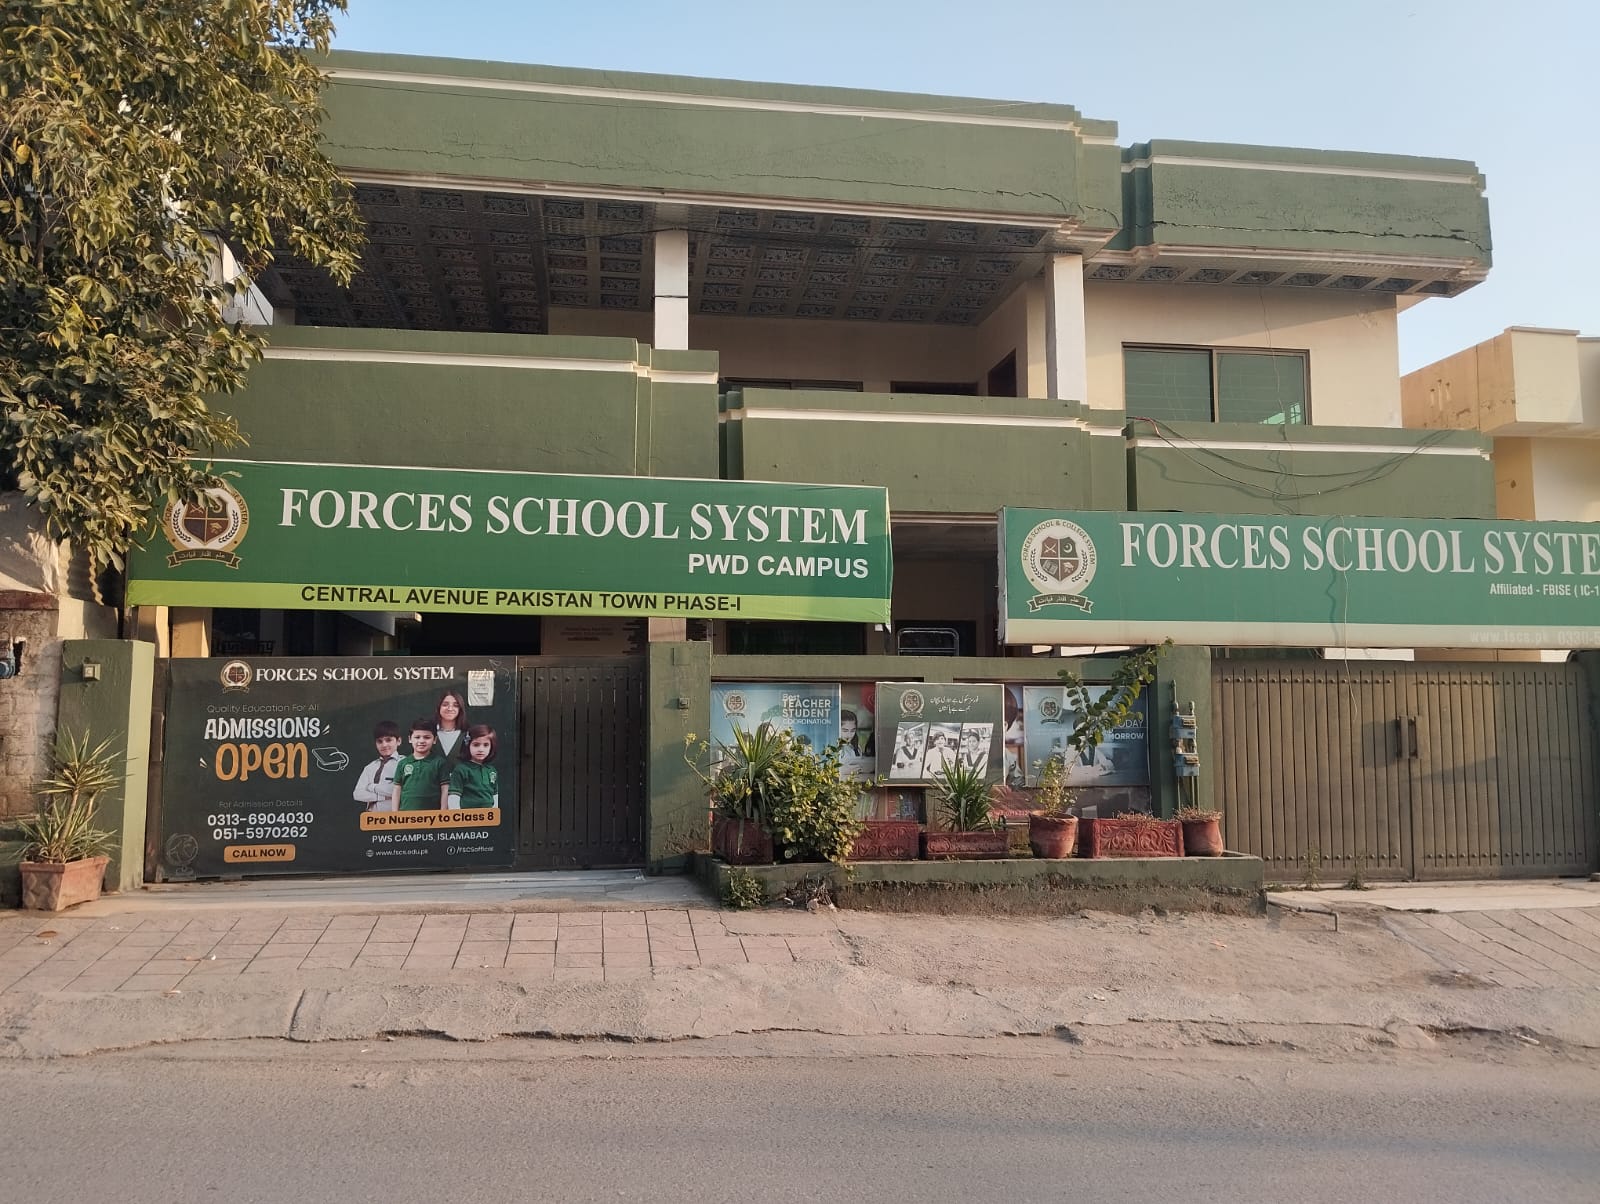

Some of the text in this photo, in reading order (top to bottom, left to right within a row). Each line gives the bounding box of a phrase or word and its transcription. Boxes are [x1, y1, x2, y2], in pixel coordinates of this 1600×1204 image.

[278, 488, 472, 533] FORCES
[486, 495, 679, 540] SCHOOL
[690, 502, 868, 545] SYSTEM
[1023, 536, 1033, 561] FORCES
[1031, 521, 1054, 538] SCHOOL
[1062, 521, 1087, 540] COLLEGE
[1085, 538, 1096, 565] SYSTEM
[1120, 522, 1600, 576] FORCES SCHOOL SYSTE
[688, 553, 869, 579] PWD CAMPUS
[1489, 583, 1533, 595] Affiliated
[1543, 584, 1571, 596] FBISE
[301, 586, 741, 612] CENTRAL AVENUE PAKISTAN TOWN PHASE-I
[256, 666, 454, 682] FORCES SCHOOL SYSTEM
[206, 703, 319, 714] Quality Education For All
[783, 699, 831, 708] TEACHER
[782, 708, 830, 718] STUDENT
[204, 717, 320, 740] ADMISSIONS
[207, 812, 314, 826] 0313-6904030
[367, 811, 494, 826] Pre Nursery to Class 8
[213, 826, 308, 840] 051-5970262
[372, 831, 489, 843] PWS CAMPUS, ISLAMABAD
[232, 848, 287, 858] CALL NOW
